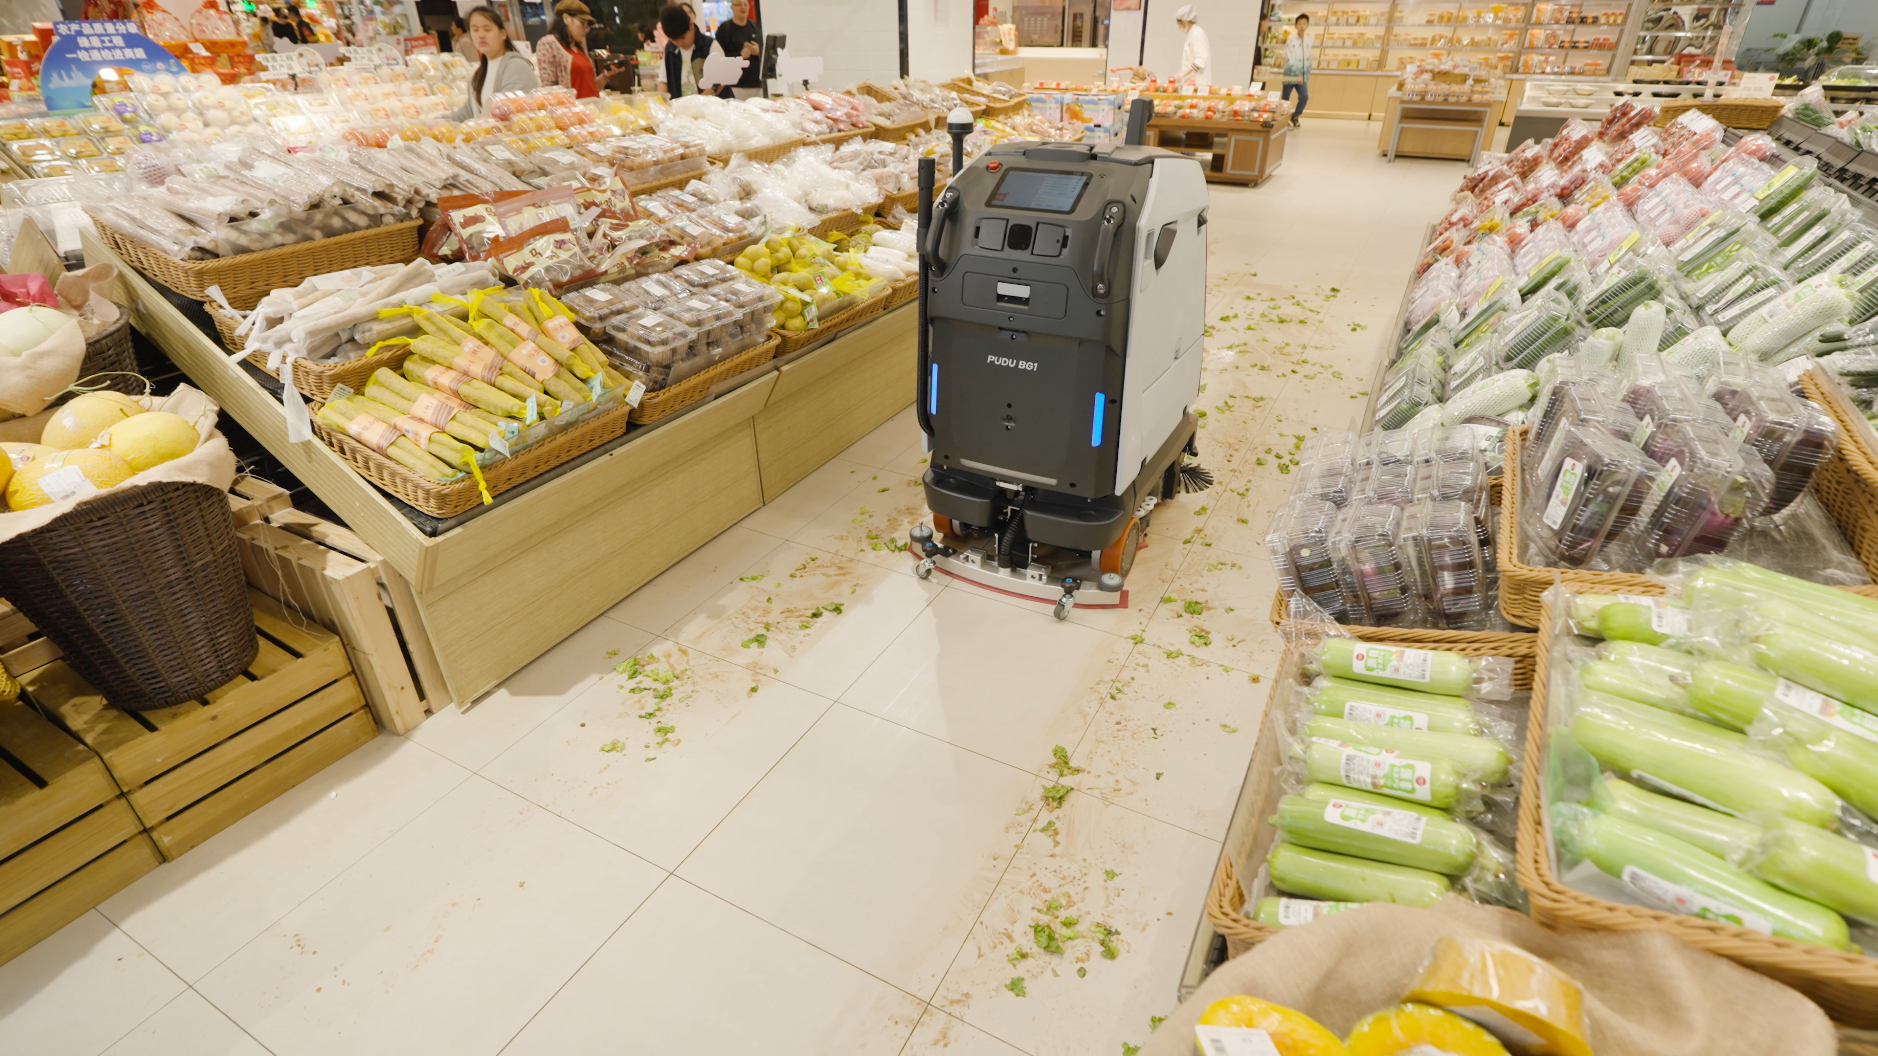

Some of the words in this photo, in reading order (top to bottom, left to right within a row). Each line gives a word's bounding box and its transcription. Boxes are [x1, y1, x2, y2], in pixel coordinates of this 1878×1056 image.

[56, 22, 140, 35] 农产品质量分级
[987, 354, 1017, 368] PUDU
[1018, 360, 1039, 371] BG1
